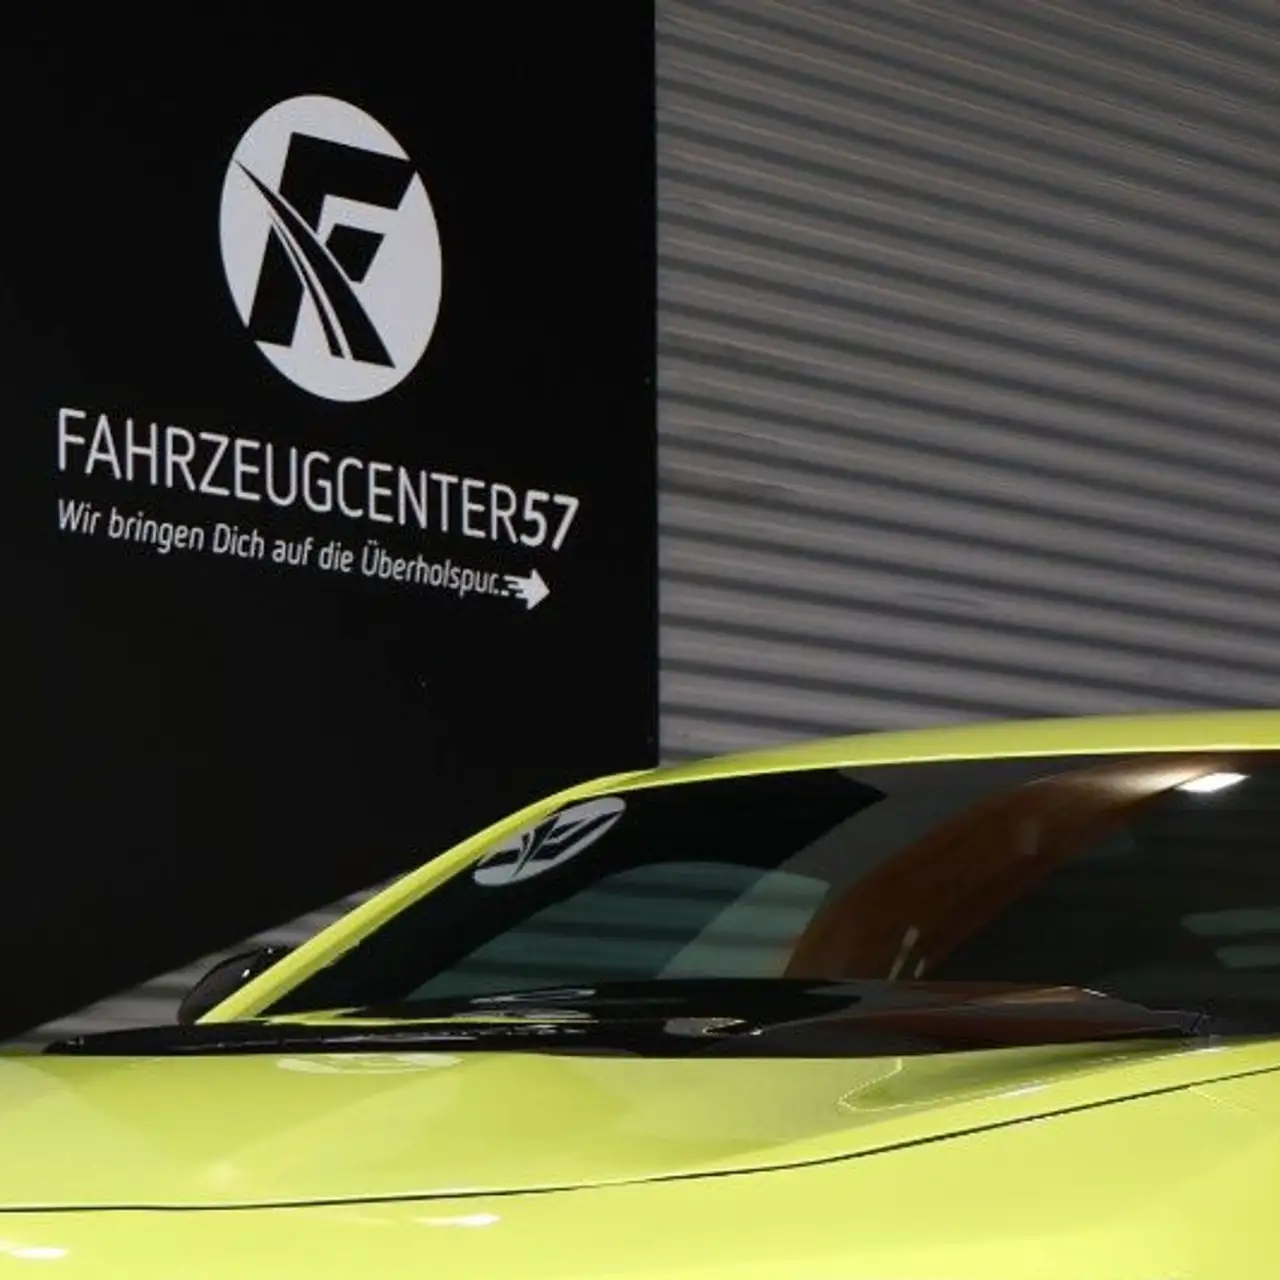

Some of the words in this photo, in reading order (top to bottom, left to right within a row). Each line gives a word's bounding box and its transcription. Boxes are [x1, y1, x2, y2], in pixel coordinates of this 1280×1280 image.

[58, 407, 580, 551] FAHRZEUGCENTER57
[58, 498, 102, 535] Wir
[107, 506, 206, 555] bringen
[212, 522, 266, 559] Dich
[271, 536, 315, 567] auf
[318, 540, 354, 573] die
